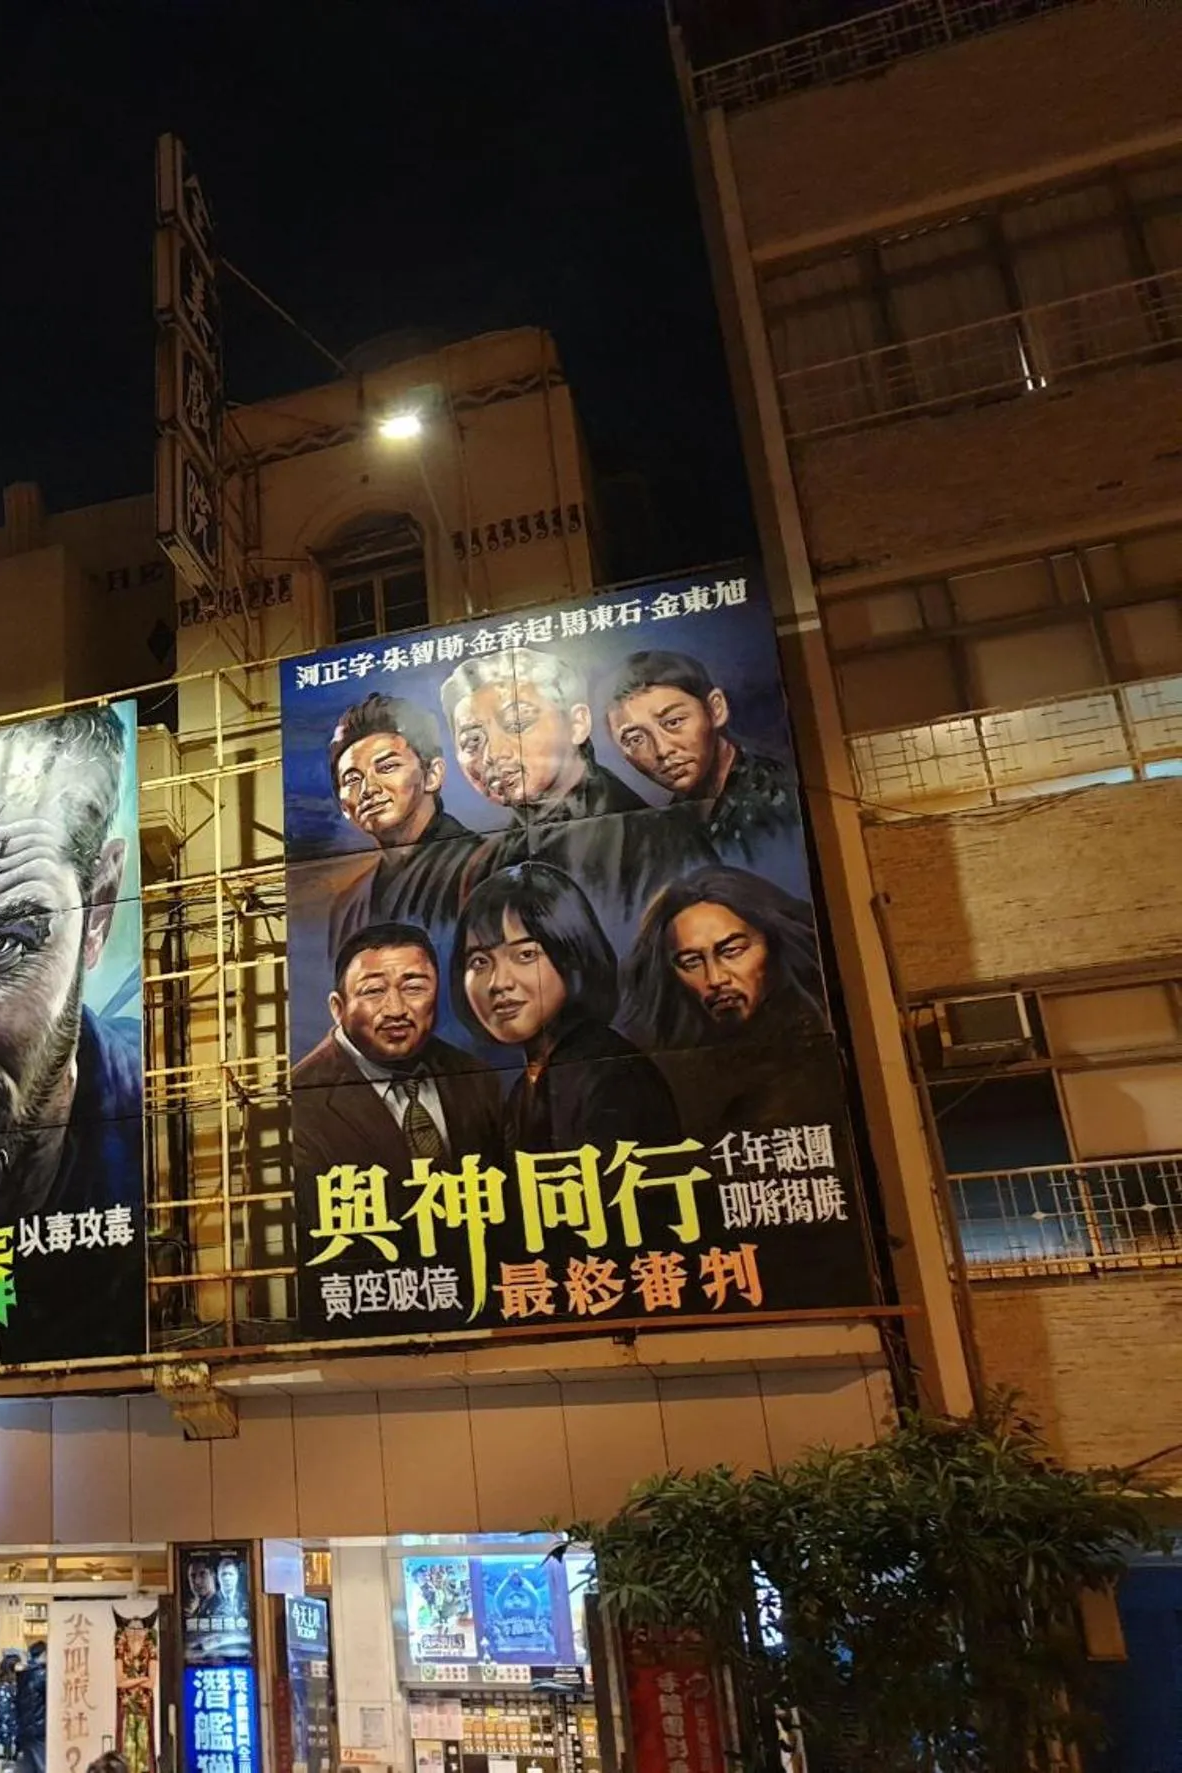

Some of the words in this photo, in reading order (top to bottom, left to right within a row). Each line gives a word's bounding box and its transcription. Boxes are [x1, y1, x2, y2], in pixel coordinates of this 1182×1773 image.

[710, 1124, 835, 1177] 千年謎團
[18, 1203, 135, 1257] 以毒攻毒
[305, 1137, 712, 1323] 與神同行
[319, 1263, 463, 1322] 賣座破億
[492, 1242, 763, 1320] 最終審判
